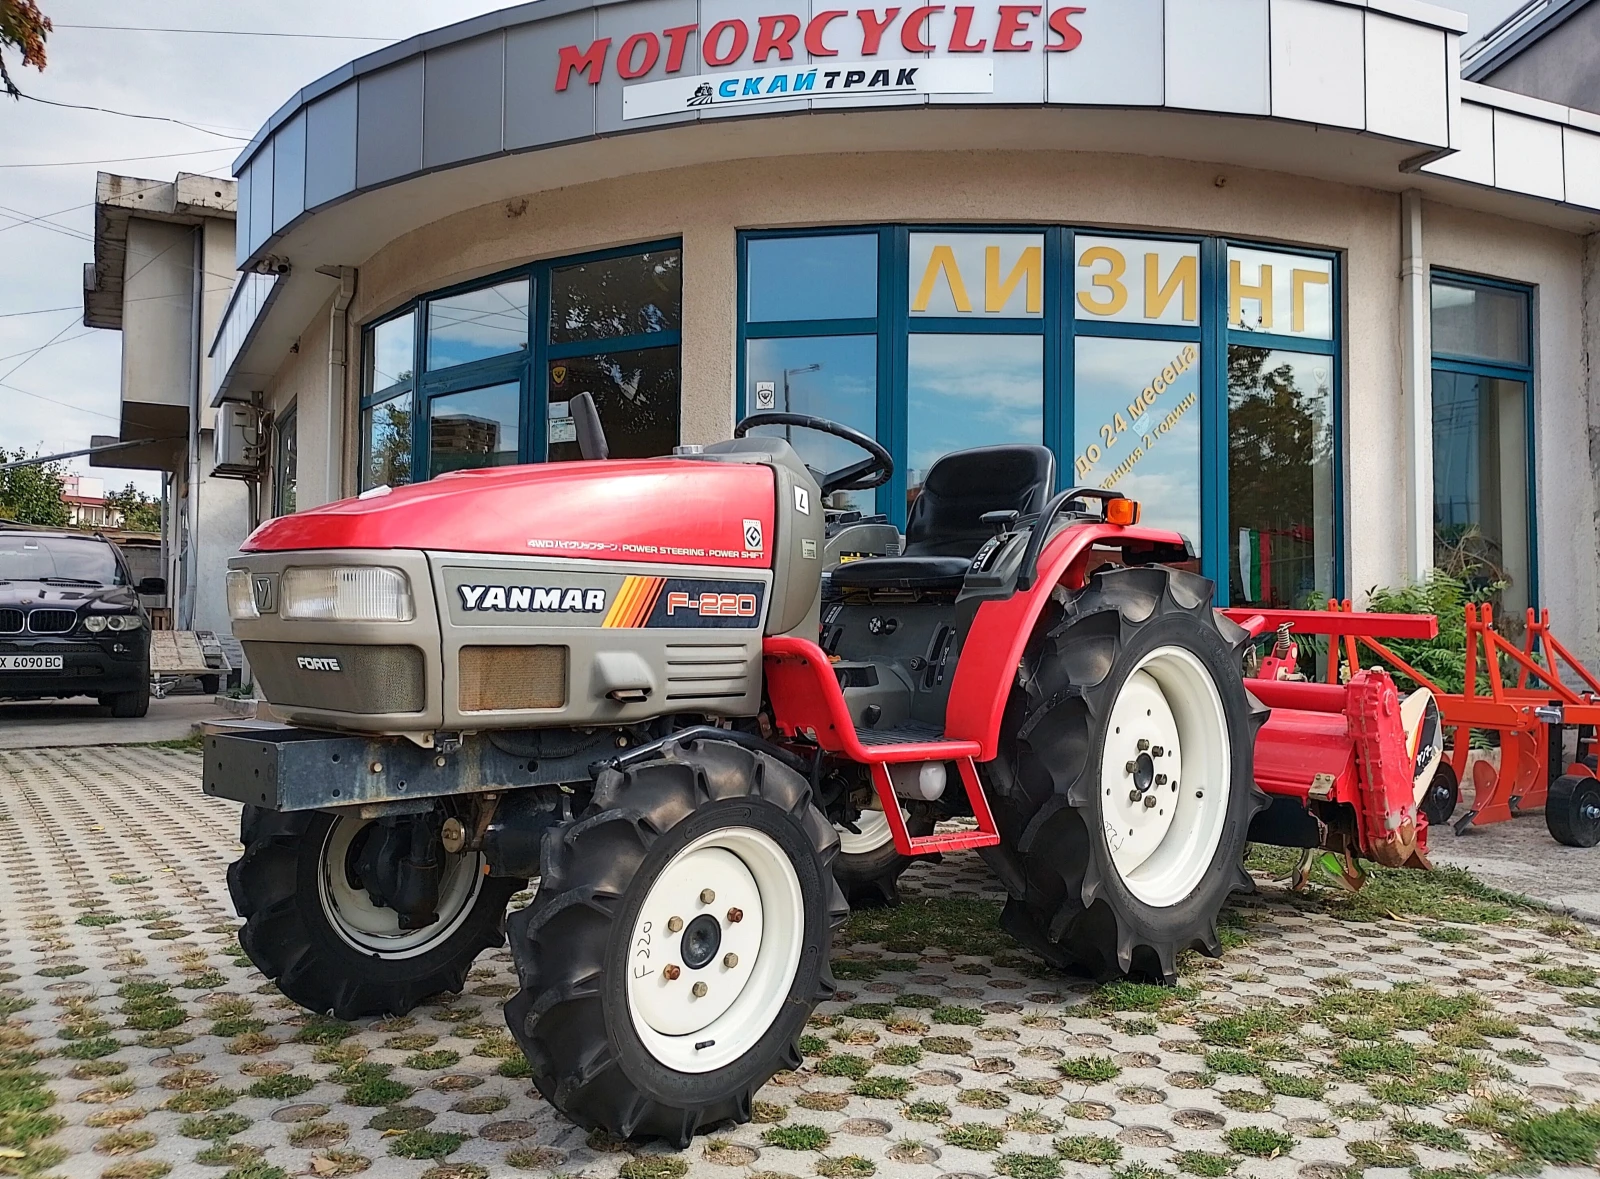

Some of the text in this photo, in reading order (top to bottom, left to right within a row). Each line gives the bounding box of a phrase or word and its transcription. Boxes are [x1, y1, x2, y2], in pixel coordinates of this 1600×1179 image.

[555, 5, 1087, 91] MOTORCYCLES
[1100, 412, 1128, 449] 24
[1126, 345, 1198, 422] месеца
[1142, 434, 1155, 450] 2
[1152, 391, 1198, 440] години
[622, 544, 658, 553] POWER
[709, 550, 740, 558] POWER
[741, 551, 765, 559] SHIFT
[459, 585, 606, 612] YANMAR
[667, 592, 756, 616] F-220
[13, 657, 43, 668] 6090
[297, 656, 341, 671] FORTE
